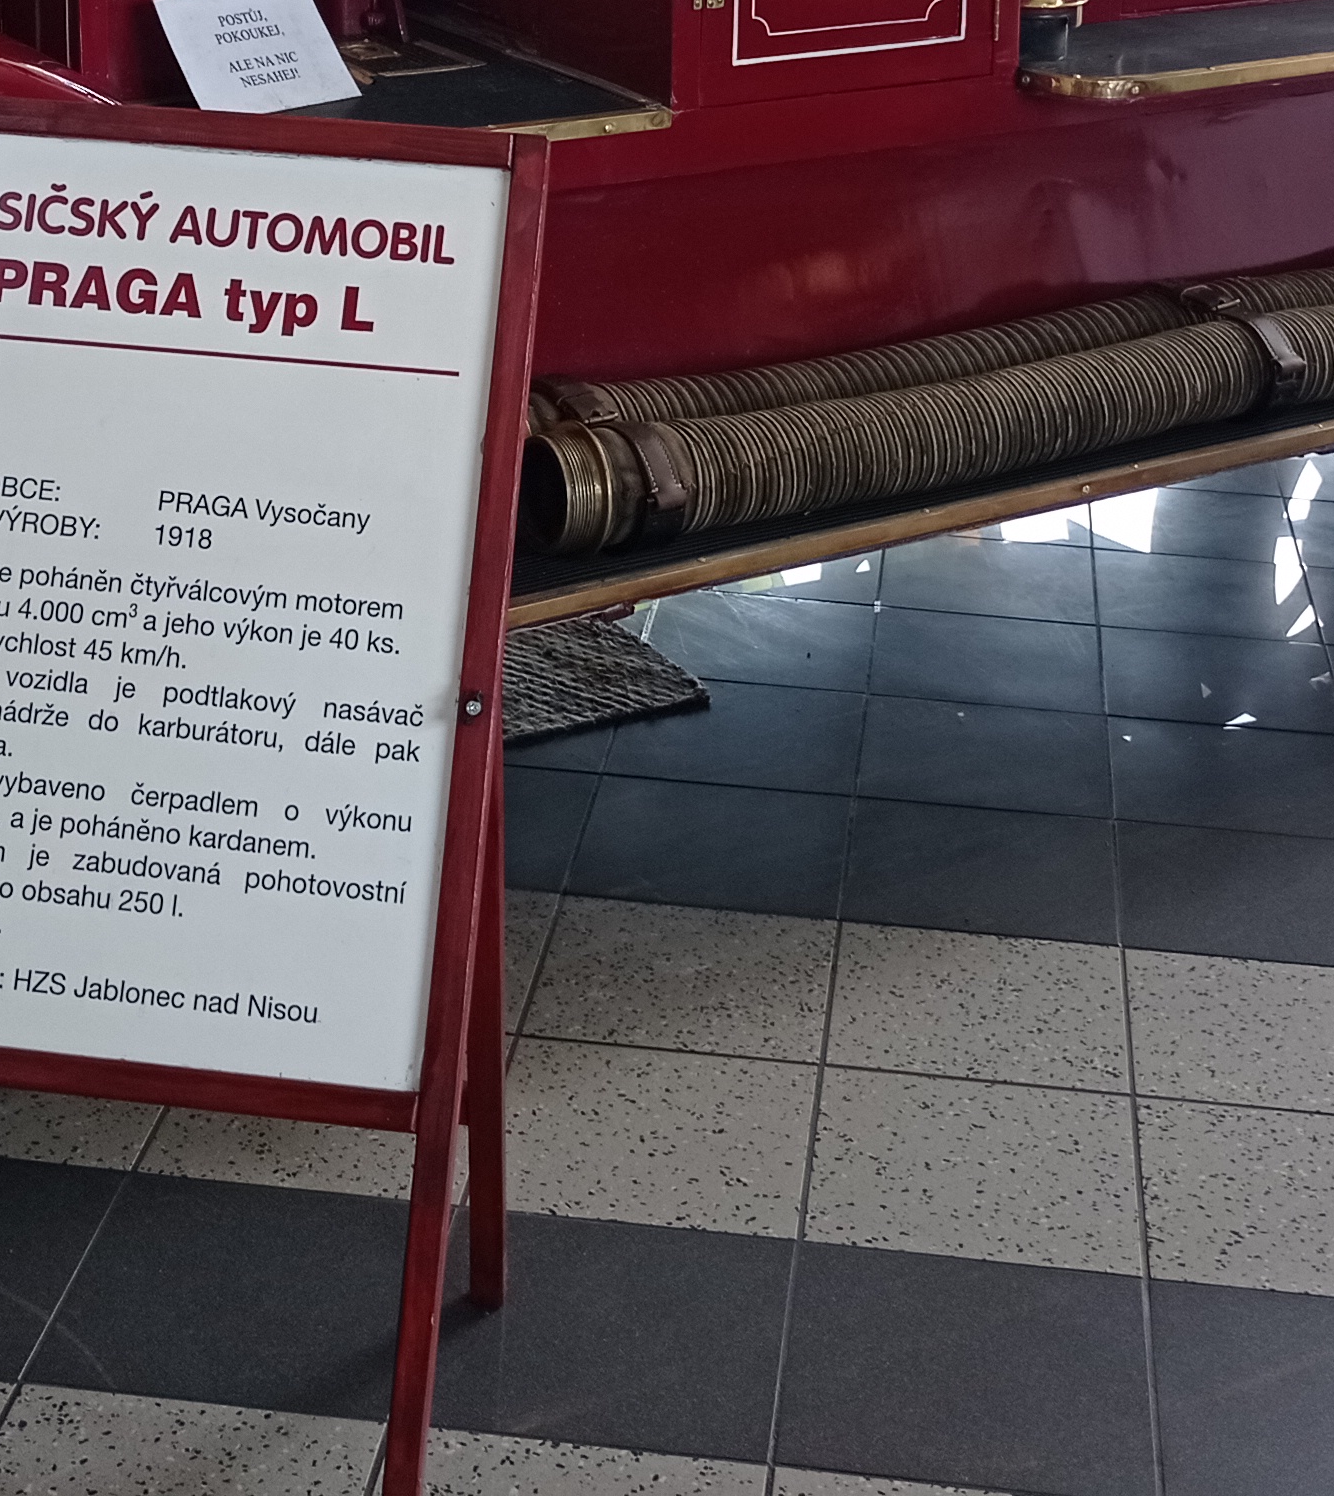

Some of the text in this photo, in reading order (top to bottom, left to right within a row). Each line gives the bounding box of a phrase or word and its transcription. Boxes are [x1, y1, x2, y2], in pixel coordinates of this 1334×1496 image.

[214, 24, 285, 45] POKOUKEJ,
[229, 51, 299, 73] ALE NA NIC
[239, 67, 301, 88] NESAHEJ!
[168, 205, 455, 266] AUTOMOBIL
[223, 278, 319, 337] typ
[340, 285, 375, 333] L
[155, 524, 213, 550] 1918
[158, 489, 371, 535] PRAGA Vysočany
[18, 565, 122, 594] poháněn
[130, 572, 287, 612] čtyřválcovým
[295, 593, 403, 621] motorem
[17, 597, 84, 624] 4.000
[142, 614, 157, 632] a
[161, 610, 215, 638] jeho
[223, 617, 293, 646] výkon
[298, 623, 322, 651] je
[328, 627, 359, 651] 40
[366, 629, 400, 655] ks.
[83, 638, 113, 662] 45
[120, 641, 186, 669] km/h.
[5, 668, 88, 695] vozidla
[112, 675, 136, 703] je
[162, 684, 297, 720] podtlakový
[323, 699, 424, 728] nasávač
[88, 708, 119, 733] do
[138, 712, 284, 753] karburátoru,
[304, 730, 356, 756] dále
[374, 739, 421, 765] pak
[10, 811, 24, 829] a
[29, 807, 53, 836] je
[59, 813, 181, 845] poháněno
[188, 824, 316, 860] kardanem.
[130, 781, 258, 818] čerpadlem
[284, 804, 300, 822] o
[325, 803, 412, 833] výkonu
[21, 879, 111, 910] obsahu
[117, 889, 164, 915] 250
[26, 843, 50, 871] je
[72, 850, 221, 886] zabudovaná
[244, 868, 408, 905] pohotovostní
[13, 967, 67, 996] HZS
[73, 975, 186, 1009] Jablonec
[192, 992, 240, 1015] nad
[247, 994, 318, 1024] Nisou
